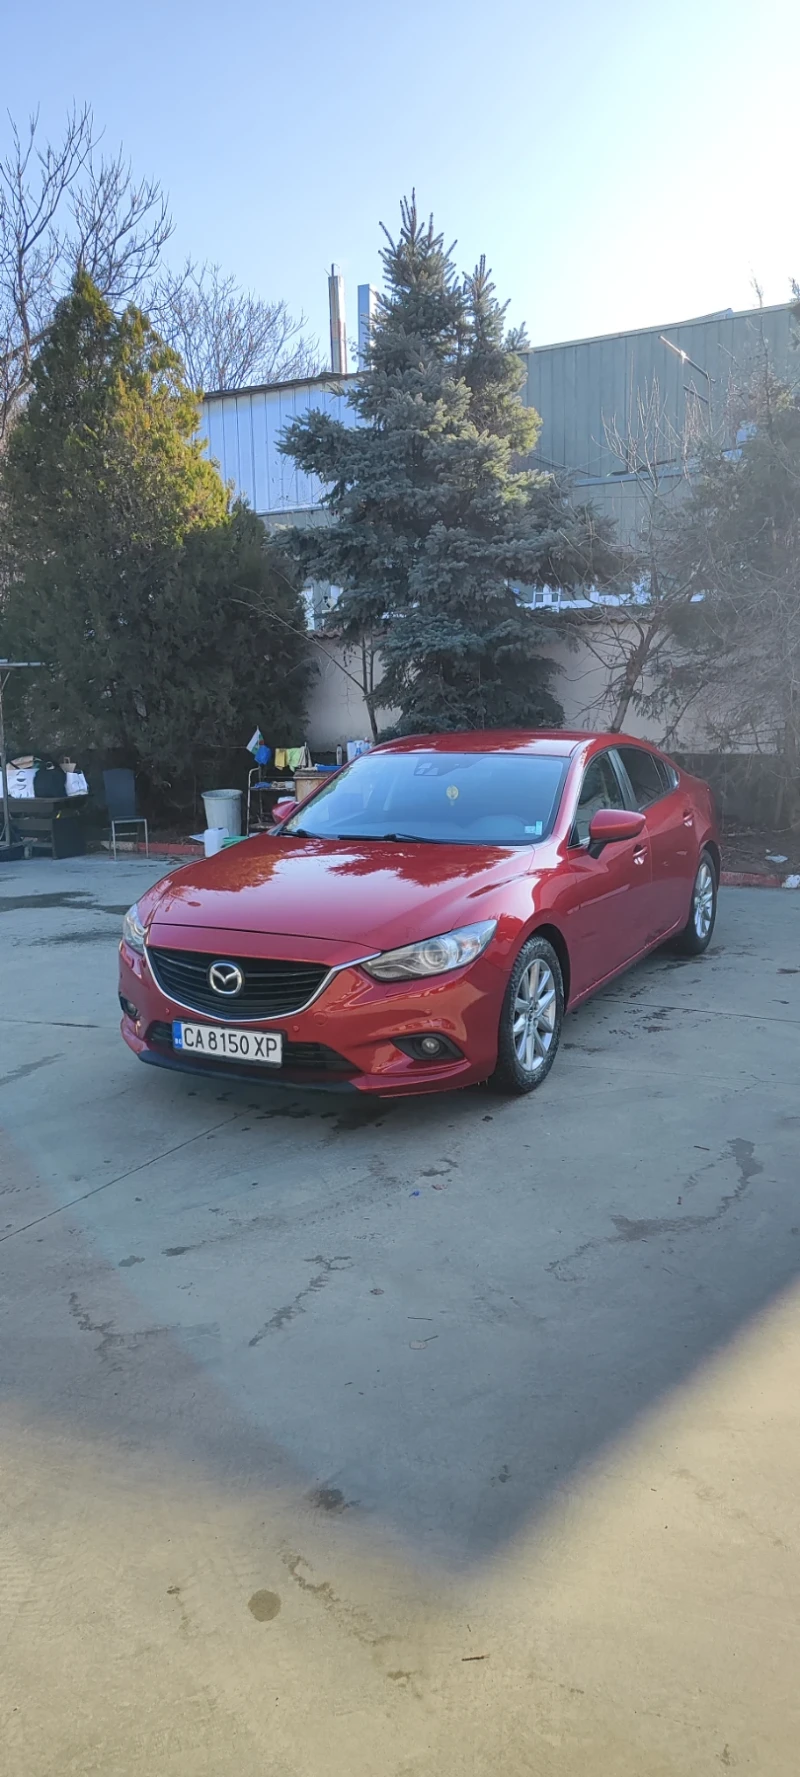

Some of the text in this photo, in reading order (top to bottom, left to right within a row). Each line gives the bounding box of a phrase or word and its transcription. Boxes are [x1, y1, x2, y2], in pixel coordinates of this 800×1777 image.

[184, 1027, 277, 1057] CA 8150 XP
